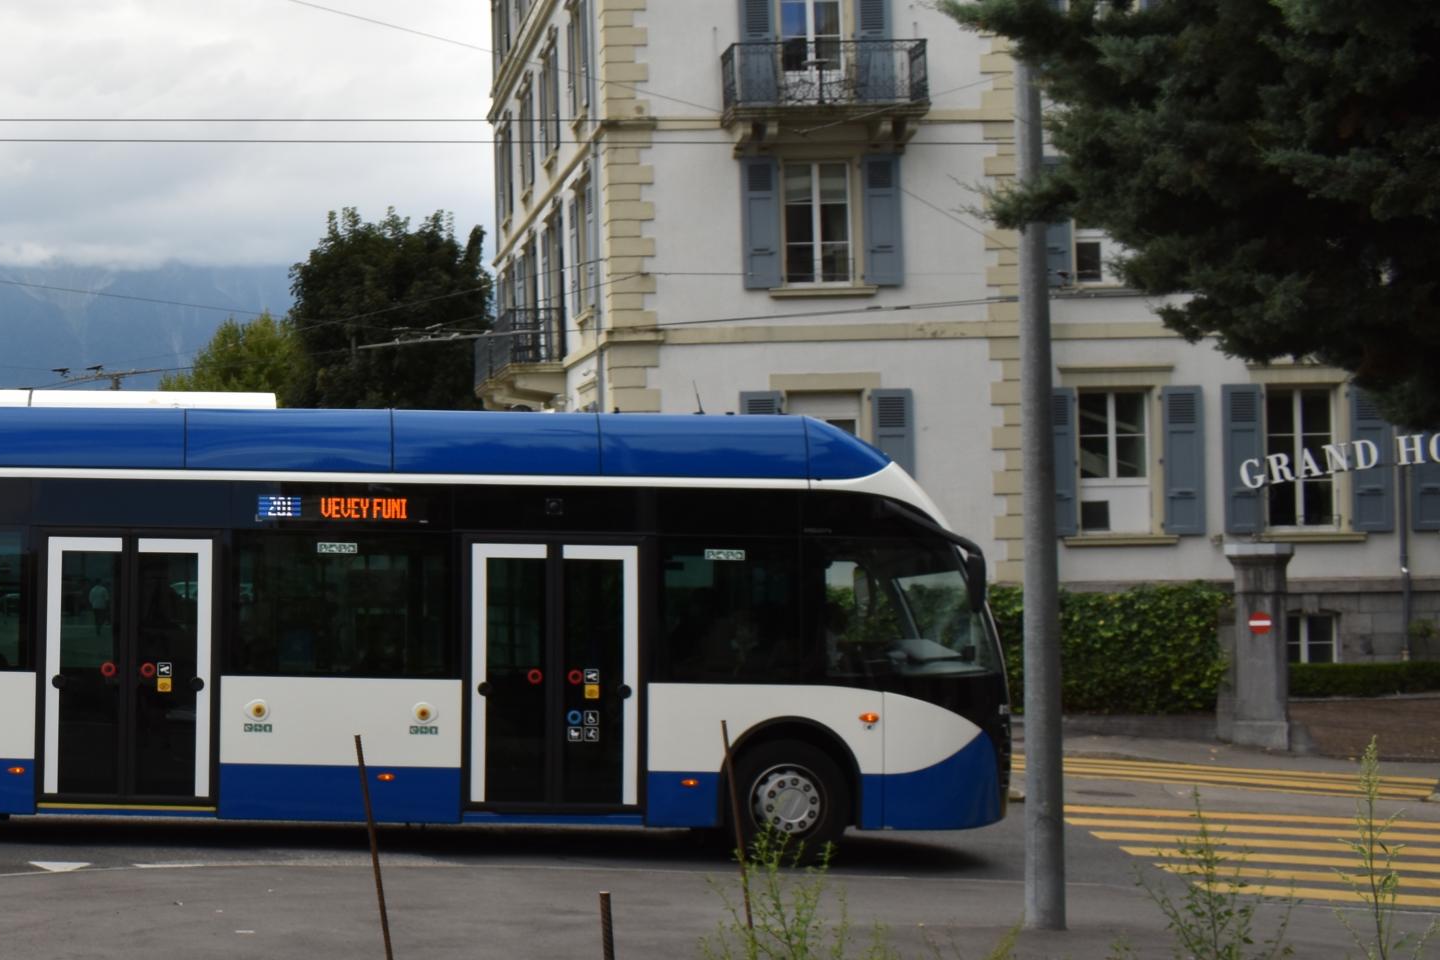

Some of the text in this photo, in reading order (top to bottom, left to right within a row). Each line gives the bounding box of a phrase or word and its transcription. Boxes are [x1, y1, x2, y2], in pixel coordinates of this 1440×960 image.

[1239, 439, 1379, 489] GRAND
[267, 496, 293, 517] 201
[320, 497, 407, 519] VEVEY FUNI
